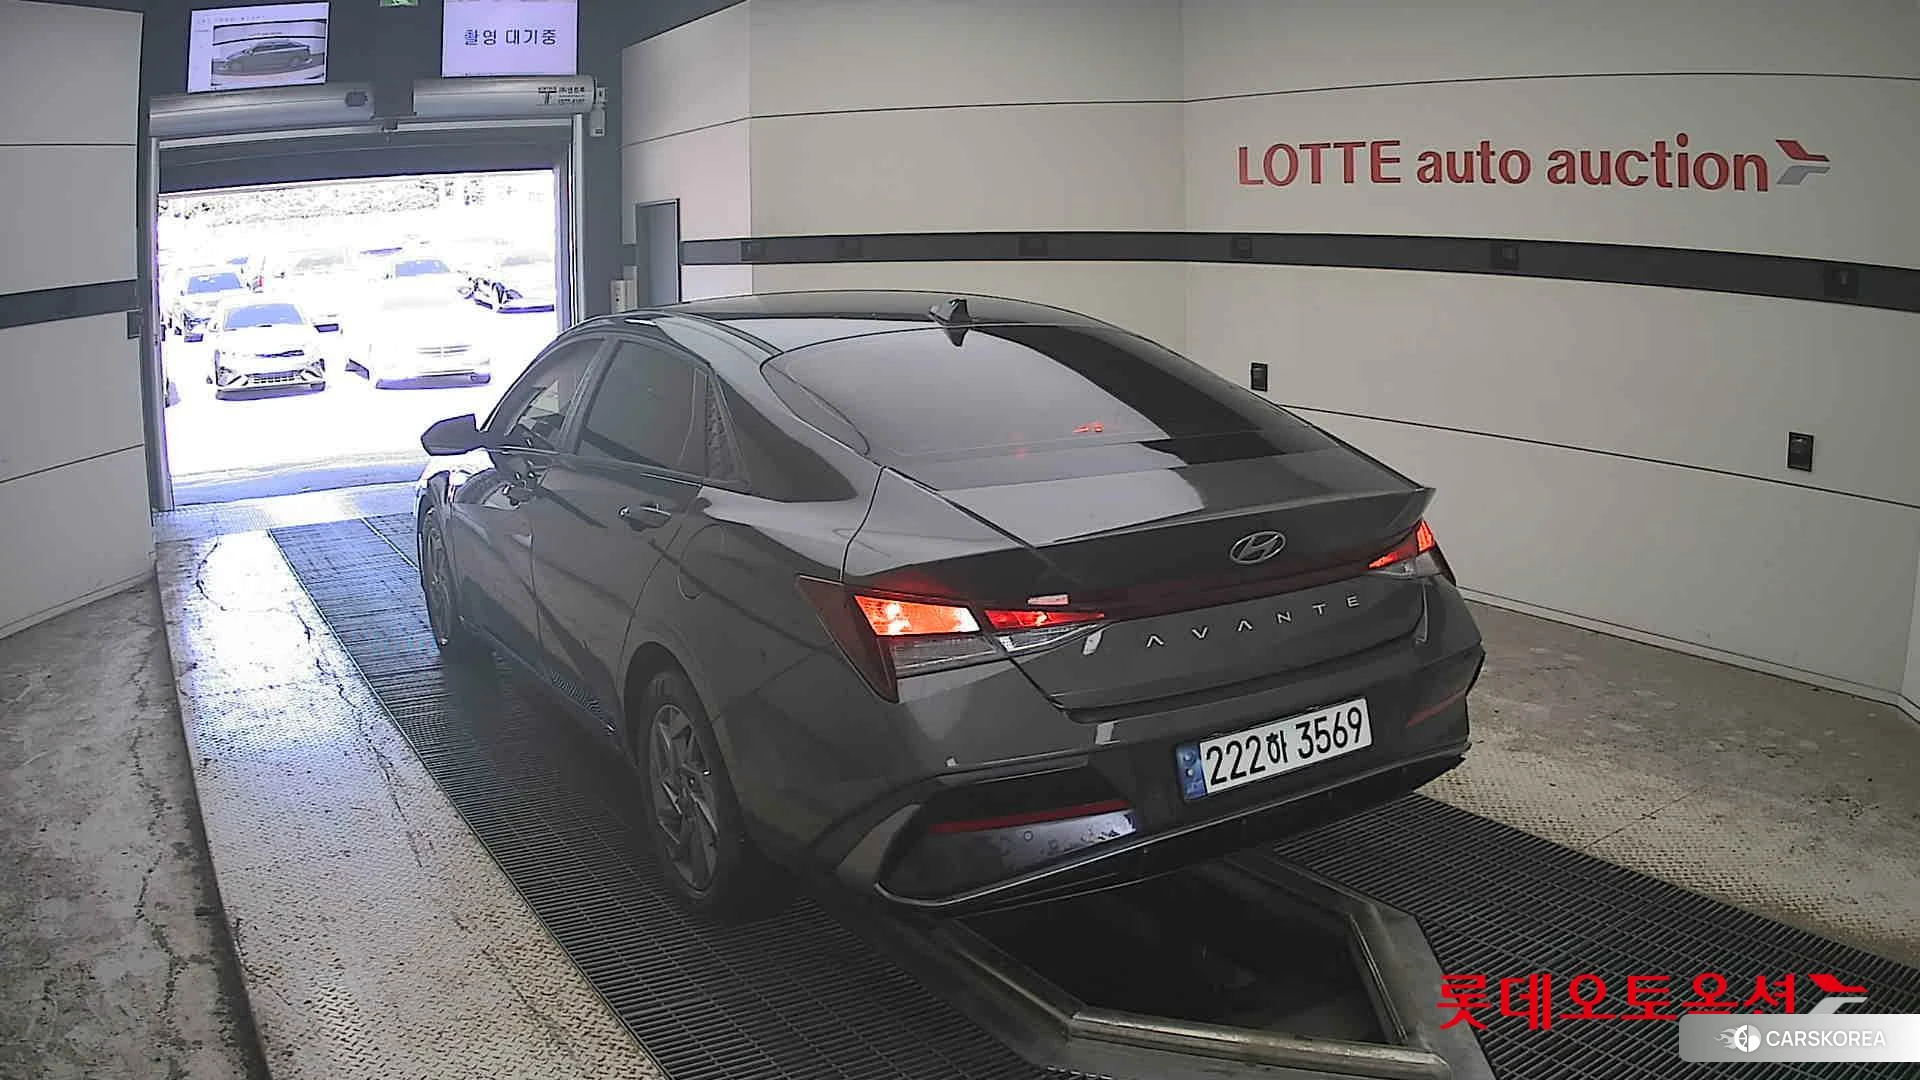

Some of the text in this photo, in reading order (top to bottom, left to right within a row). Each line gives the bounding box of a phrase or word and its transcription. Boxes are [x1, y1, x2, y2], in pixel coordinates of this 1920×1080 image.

[505, 29, 557, 46] 대기중
[1238, 132, 1769, 192] LOTTE auto auction
[1145, 595, 1361, 649] AVANTE
[1206, 706, 1362, 786] 222하 3569
